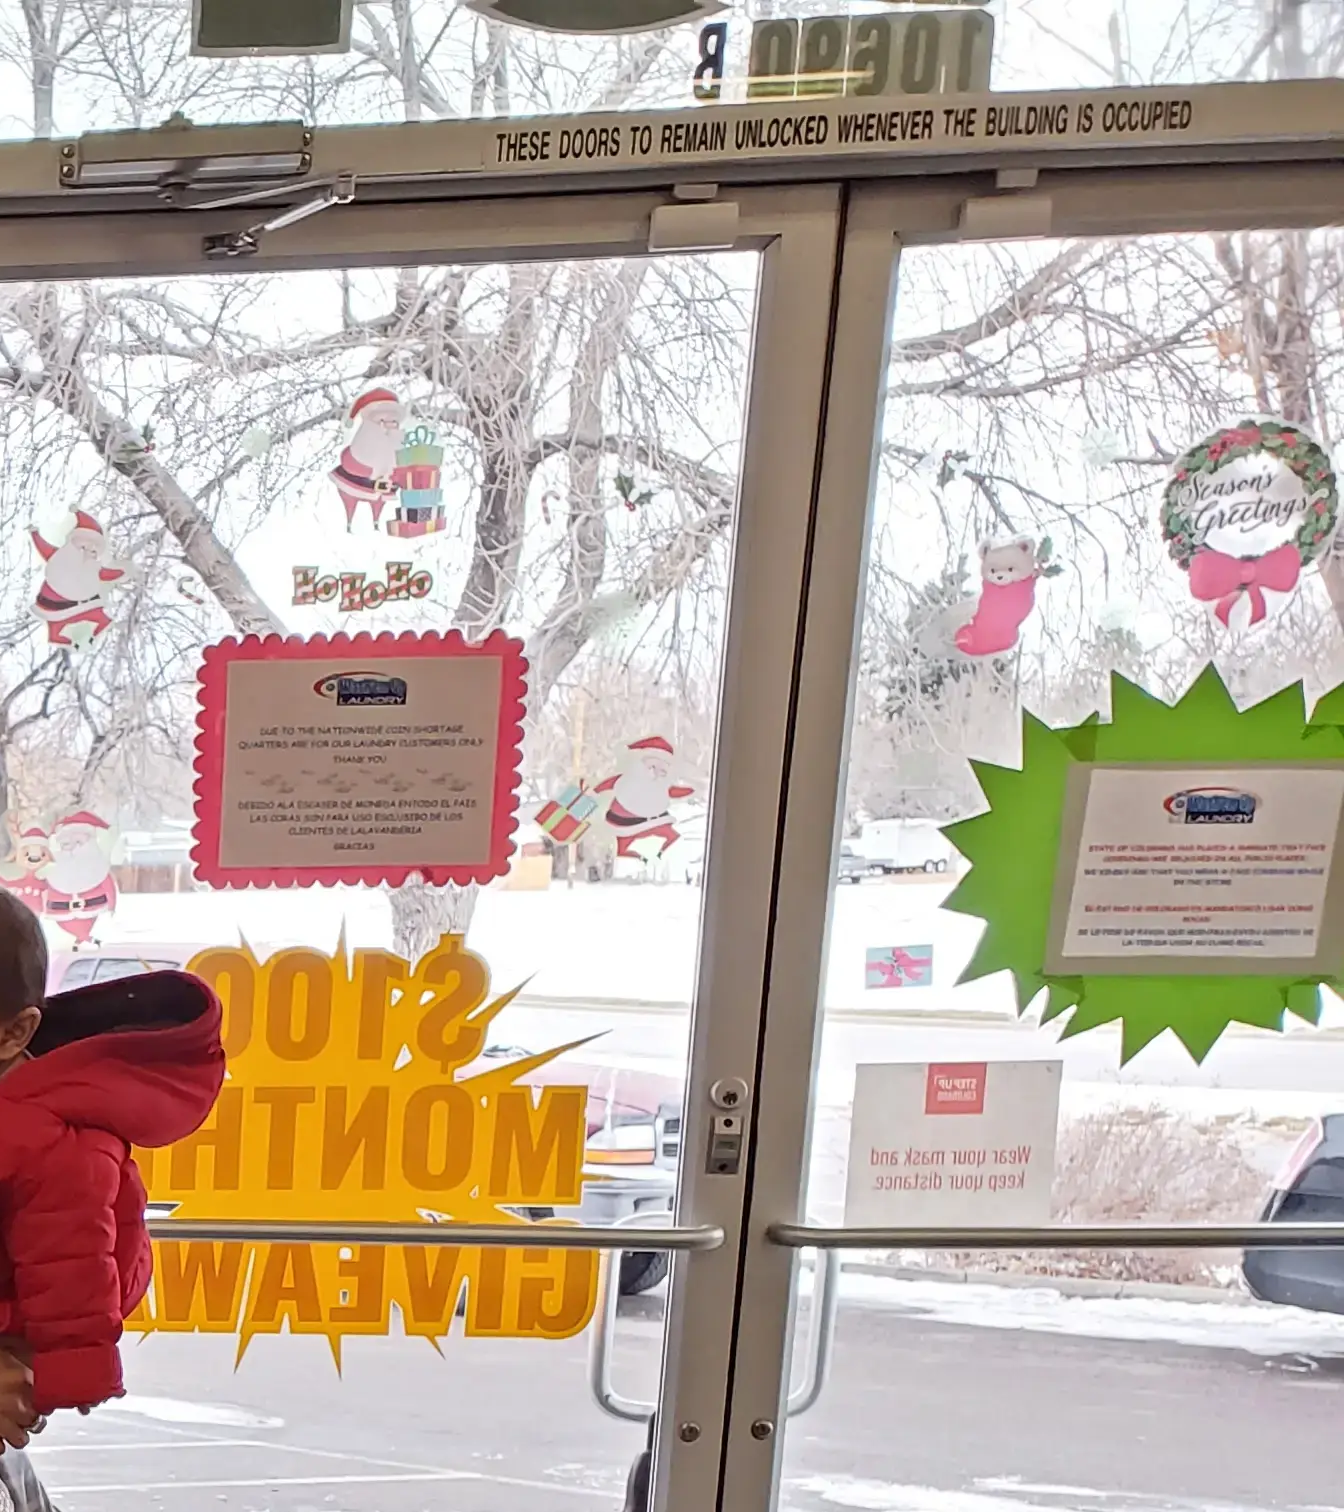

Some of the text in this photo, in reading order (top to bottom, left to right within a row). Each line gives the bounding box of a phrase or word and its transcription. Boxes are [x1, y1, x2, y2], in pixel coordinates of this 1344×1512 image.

[495, 99, 1193, 163] THESE DOORS TO REMAIN UNLOCKED WHENEVER THE BUILDING IS OCCUPIED
[1178, 490, 1324, 542] Greetings
[340, 696, 405, 705] LAUNDRY
[260, 724, 464, 736] DUE TO THE NATIONWIDE COIN SHORTAGE
[238, 740, 288, 750] QUARTERS
[311, 740, 329, 749] FOR
[331, 739, 351, 749] OUR
[353, 738, 397, 748] LAUNDRY
[399, 738, 456, 748] CUSTOMERS
[458, 737, 483, 747] ONLY
[333, 755, 387, 764] THANK YOU
[238, 800, 275, 810] DEBIDO
[250, 814, 268, 823] LAS
[1187, 813, 1253, 824] LAUNDRY
[333, 841, 375, 851] GRACIAS
